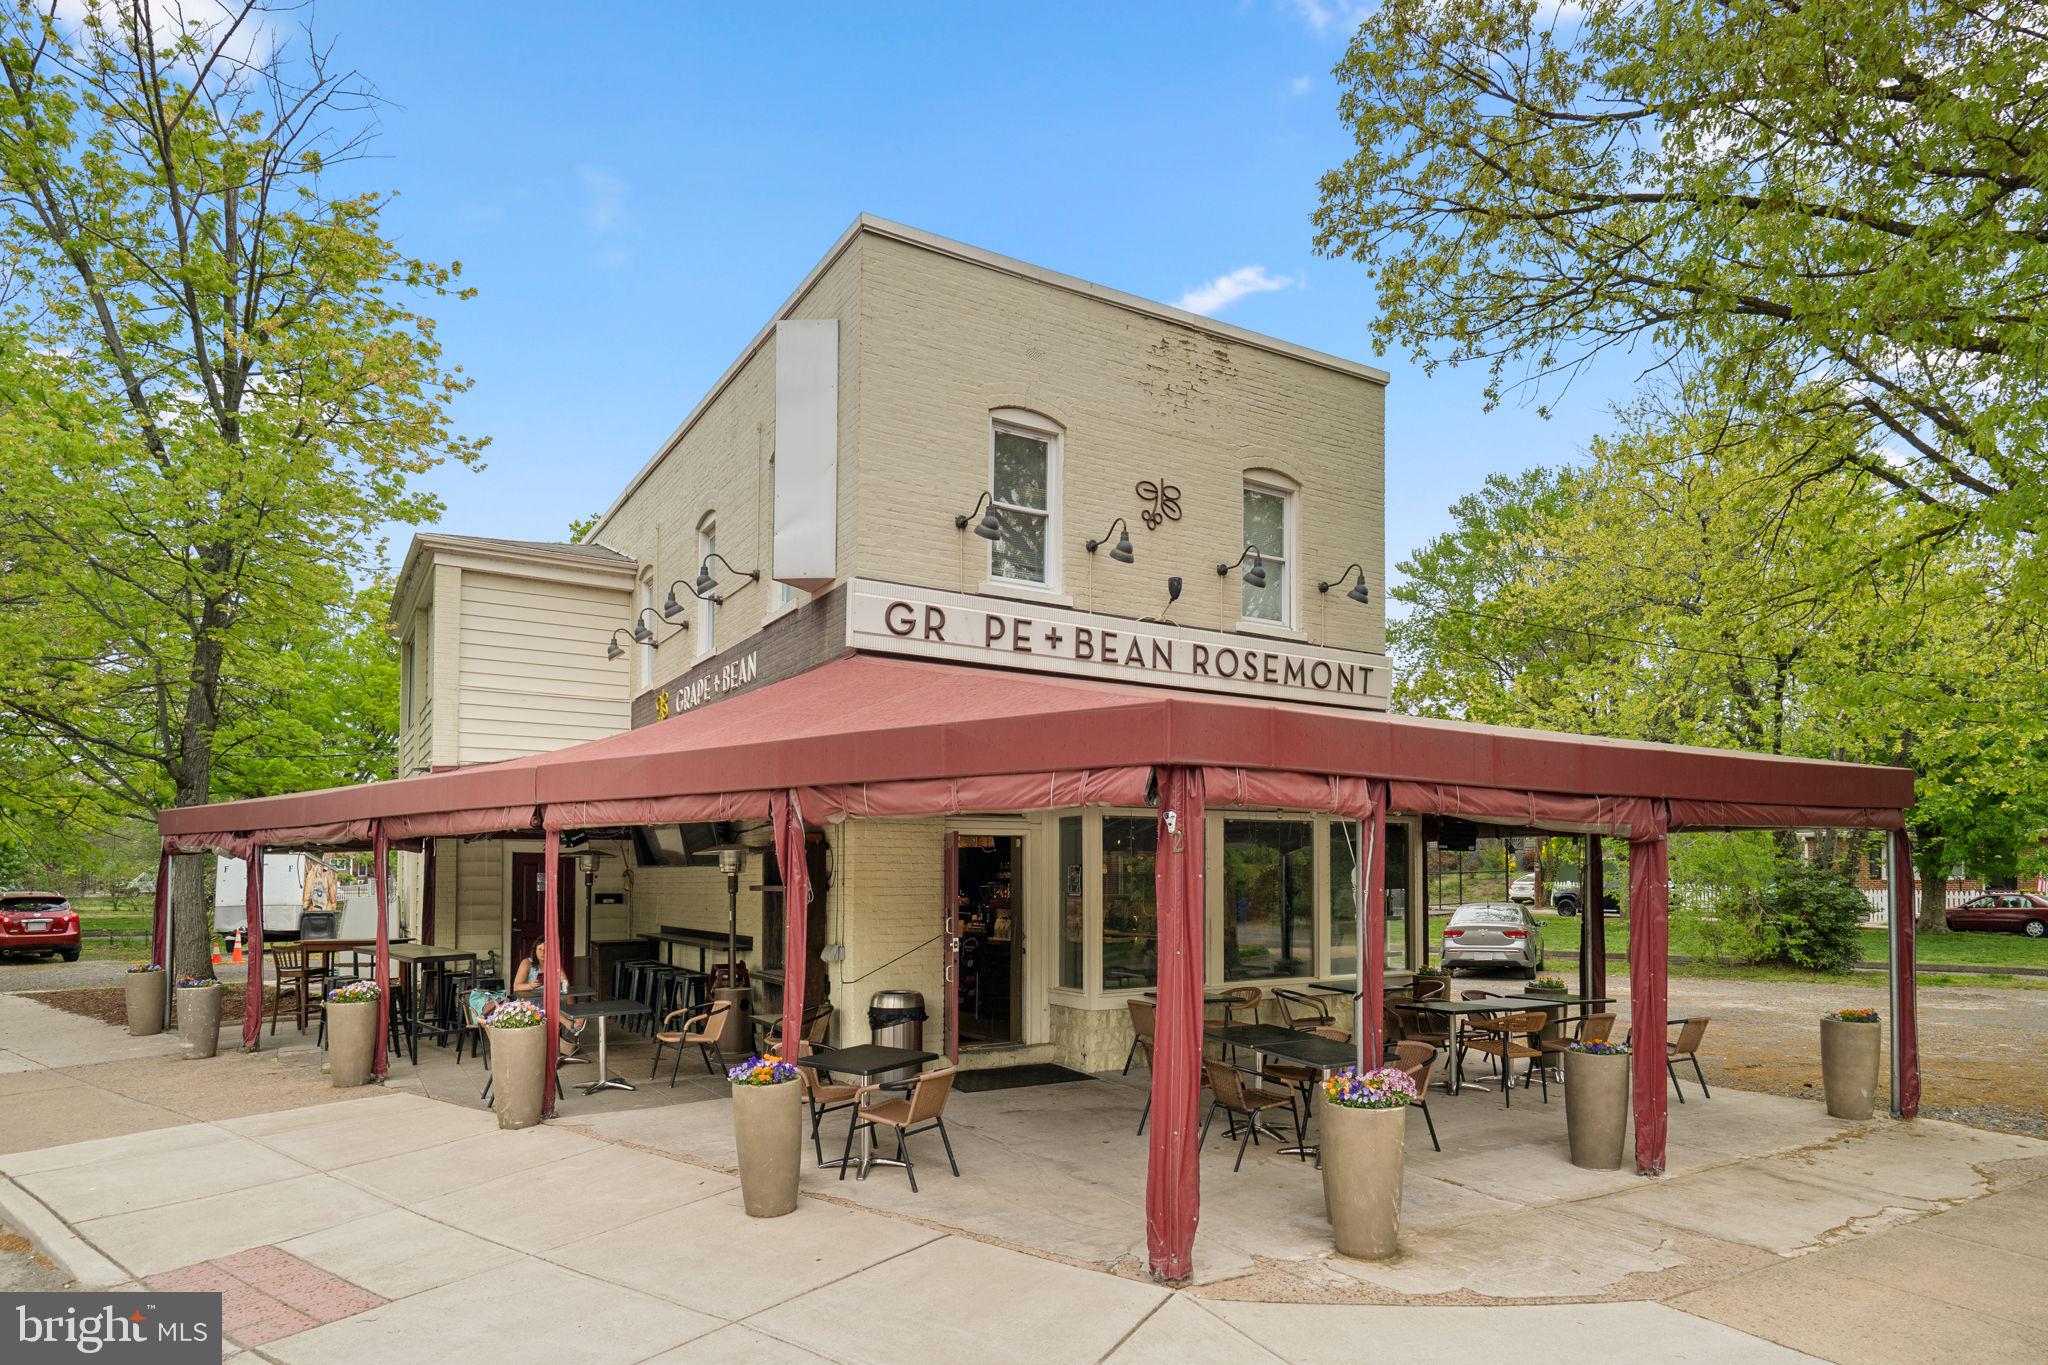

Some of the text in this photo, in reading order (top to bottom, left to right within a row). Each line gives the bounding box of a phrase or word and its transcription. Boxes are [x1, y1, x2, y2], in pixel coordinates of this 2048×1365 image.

[675, 674, 711, 713] GRAPE
[722, 650, 757, 692] BEAN
[885, 600, 946, 642] GR
[1192, 643, 1374, 695] ROSEMONT
